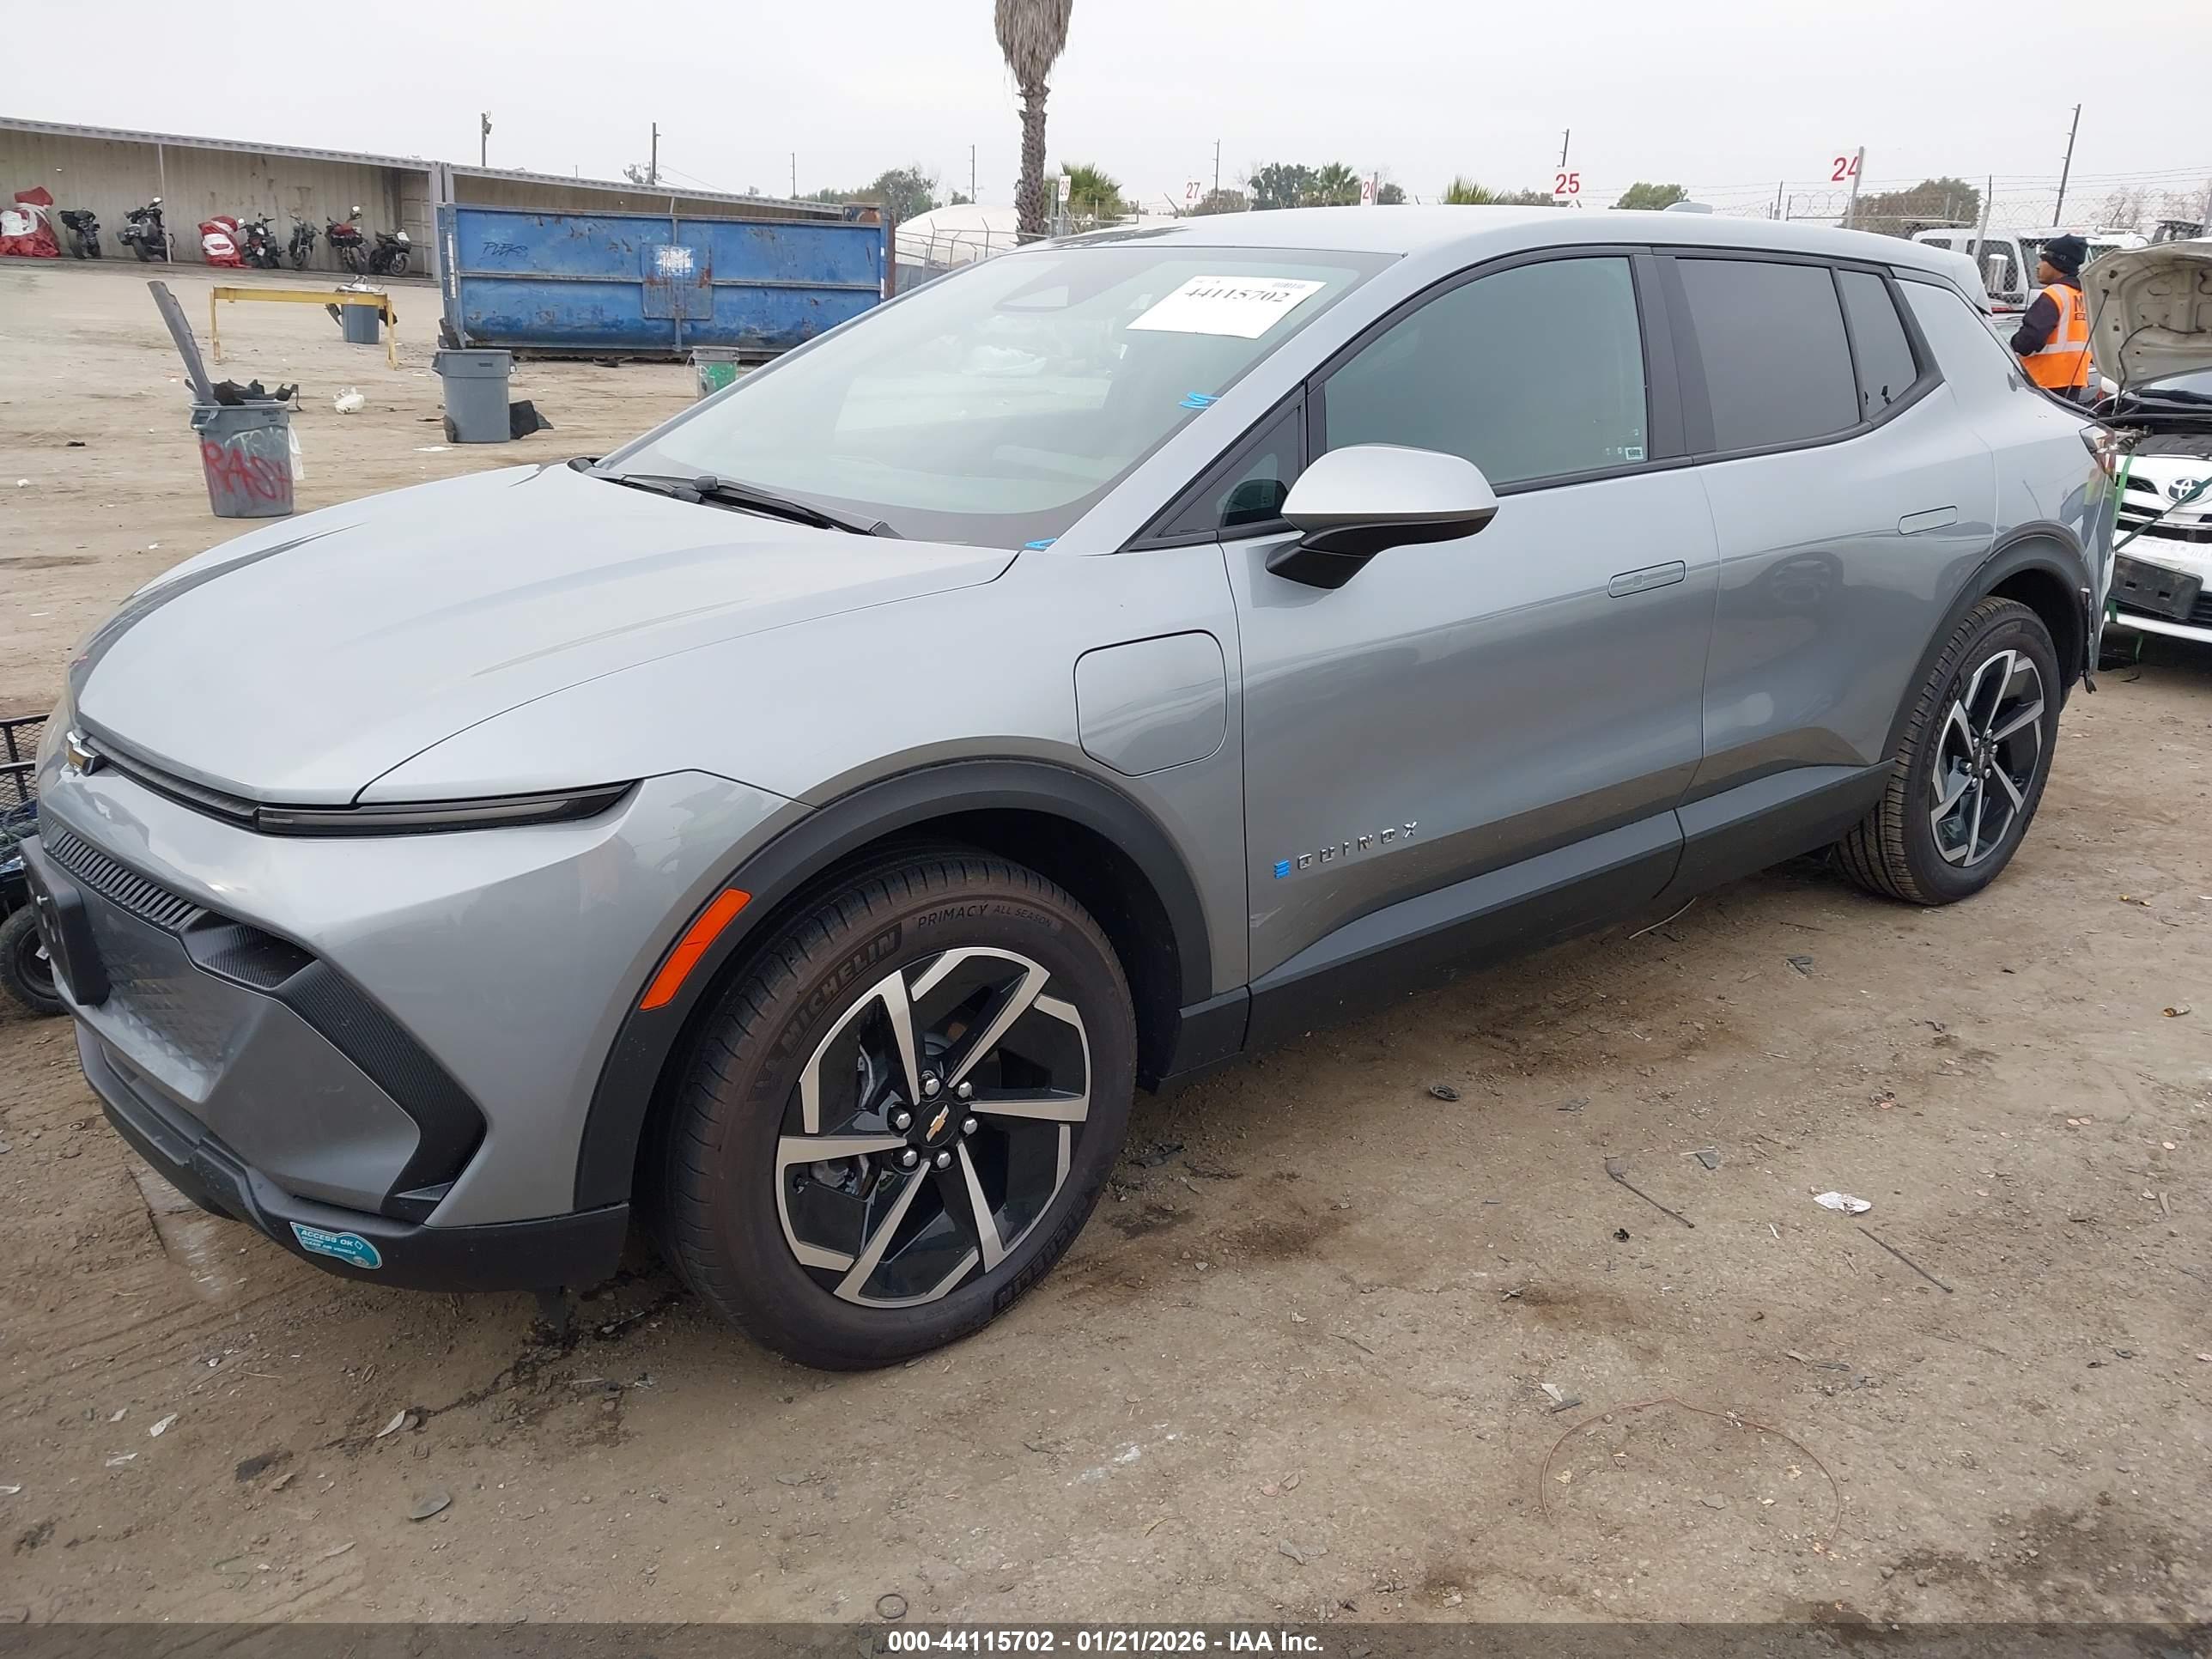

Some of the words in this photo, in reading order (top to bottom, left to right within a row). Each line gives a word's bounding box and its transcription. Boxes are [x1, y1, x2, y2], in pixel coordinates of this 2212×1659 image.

[1186, 181, 1201, 199] 27
[1554, 173, 1580, 194] 25
[1185, 287, 1291, 302] 44115702
[918, 903, 989, 928] PRIMACY
[994, 905, 1011, 915] ALL
[1014, 908, 1053, 927] SEASON
[781, 931, 896, 1053] MICHELIN
[301, 1230, 337, 1243] ACCESS
